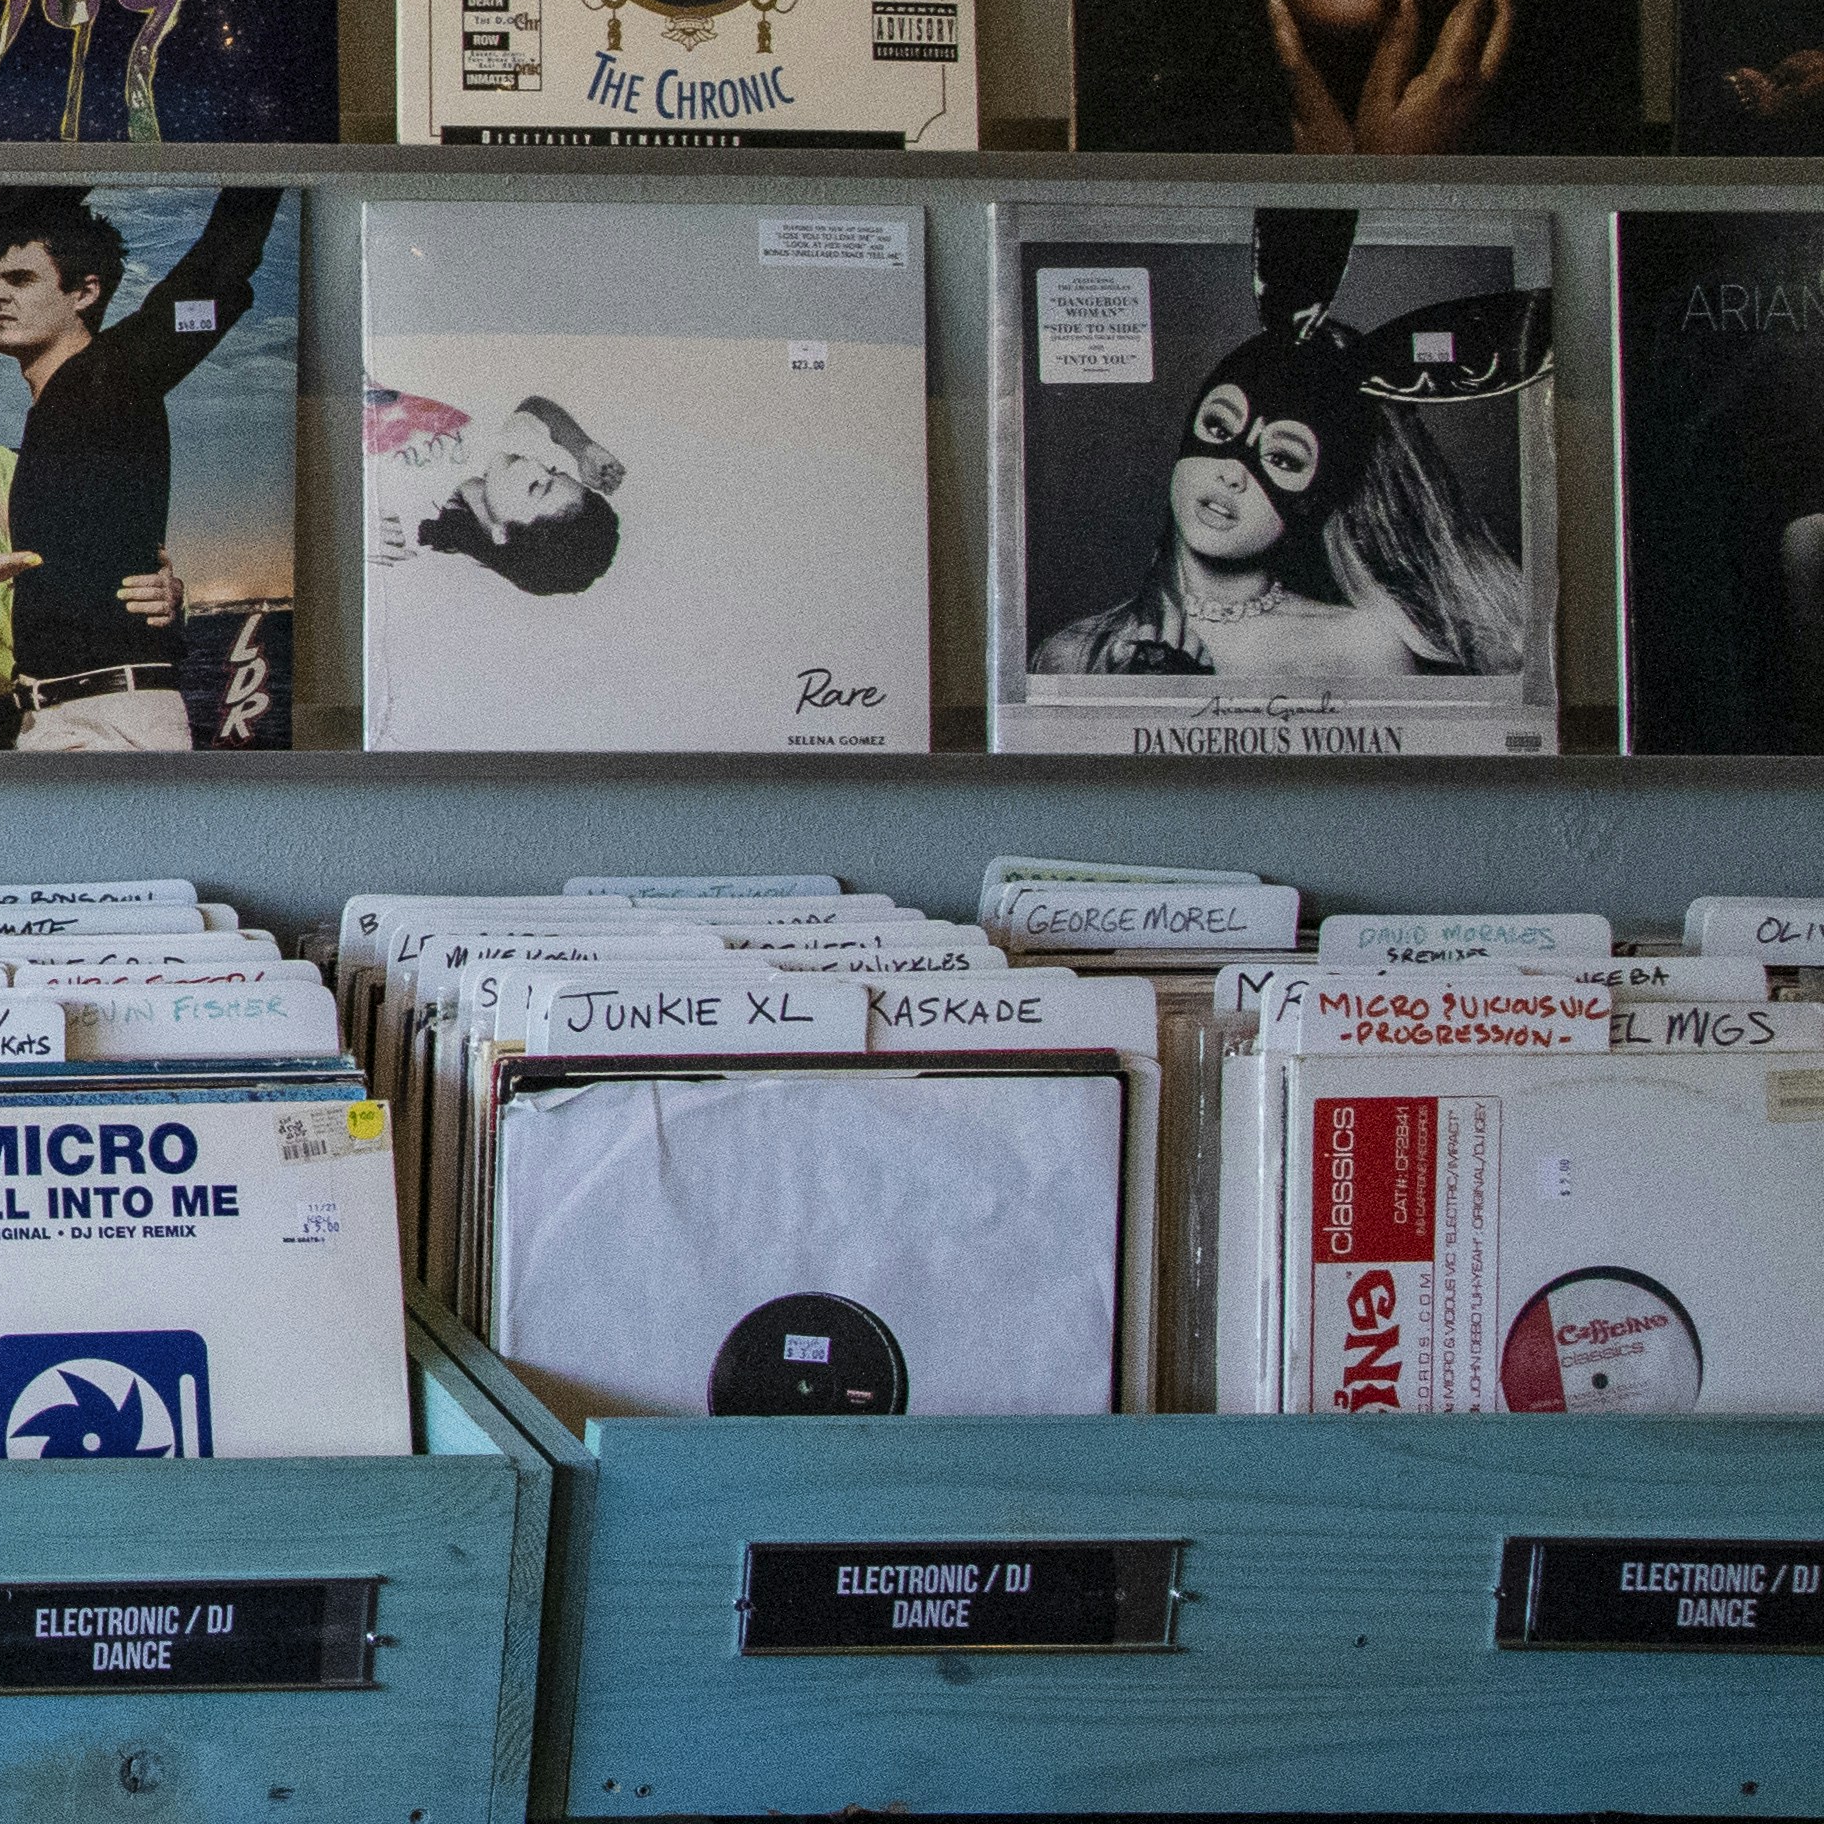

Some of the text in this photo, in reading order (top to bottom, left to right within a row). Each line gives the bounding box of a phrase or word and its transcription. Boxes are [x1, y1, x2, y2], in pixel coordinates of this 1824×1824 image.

[472, 34, 501, 47] ROW
[791, 360, 826, 371] $23.00
[795, 667, 887, 715] Rare
[787, 734, 887, 746] SELENA GOMEZ
[1134, 726, 1405, 755] DANGEROUS WOMAN
[1025, 902, 1248, 937] GEORGE MOREL
[558, 988, 814, 1034] JUNKIE XL
[869, 988, 1043, 1030] KASKADE
[49, 1187, 152, 1220] INTO
[172, 1185, 241, 1218] ME
[71, 1226, 95, 1241] DJ
[99, 1226, 138, 1241] ICEY
[143, 1224, 197, 1240] REMIX
[836, 1564, 1031, 1595] ELECTRONIC DJ
[1621, 1562, 1821, 1594] ELECTRONIC DJ
[34, 1604, 234, 1638] ELECTRONIC DJ
[892, 1599, 970, 1629] DANCE
[1677, 1598, 1757, 1628] DANCE
[92, 1640, 172, 1671] DANCE
